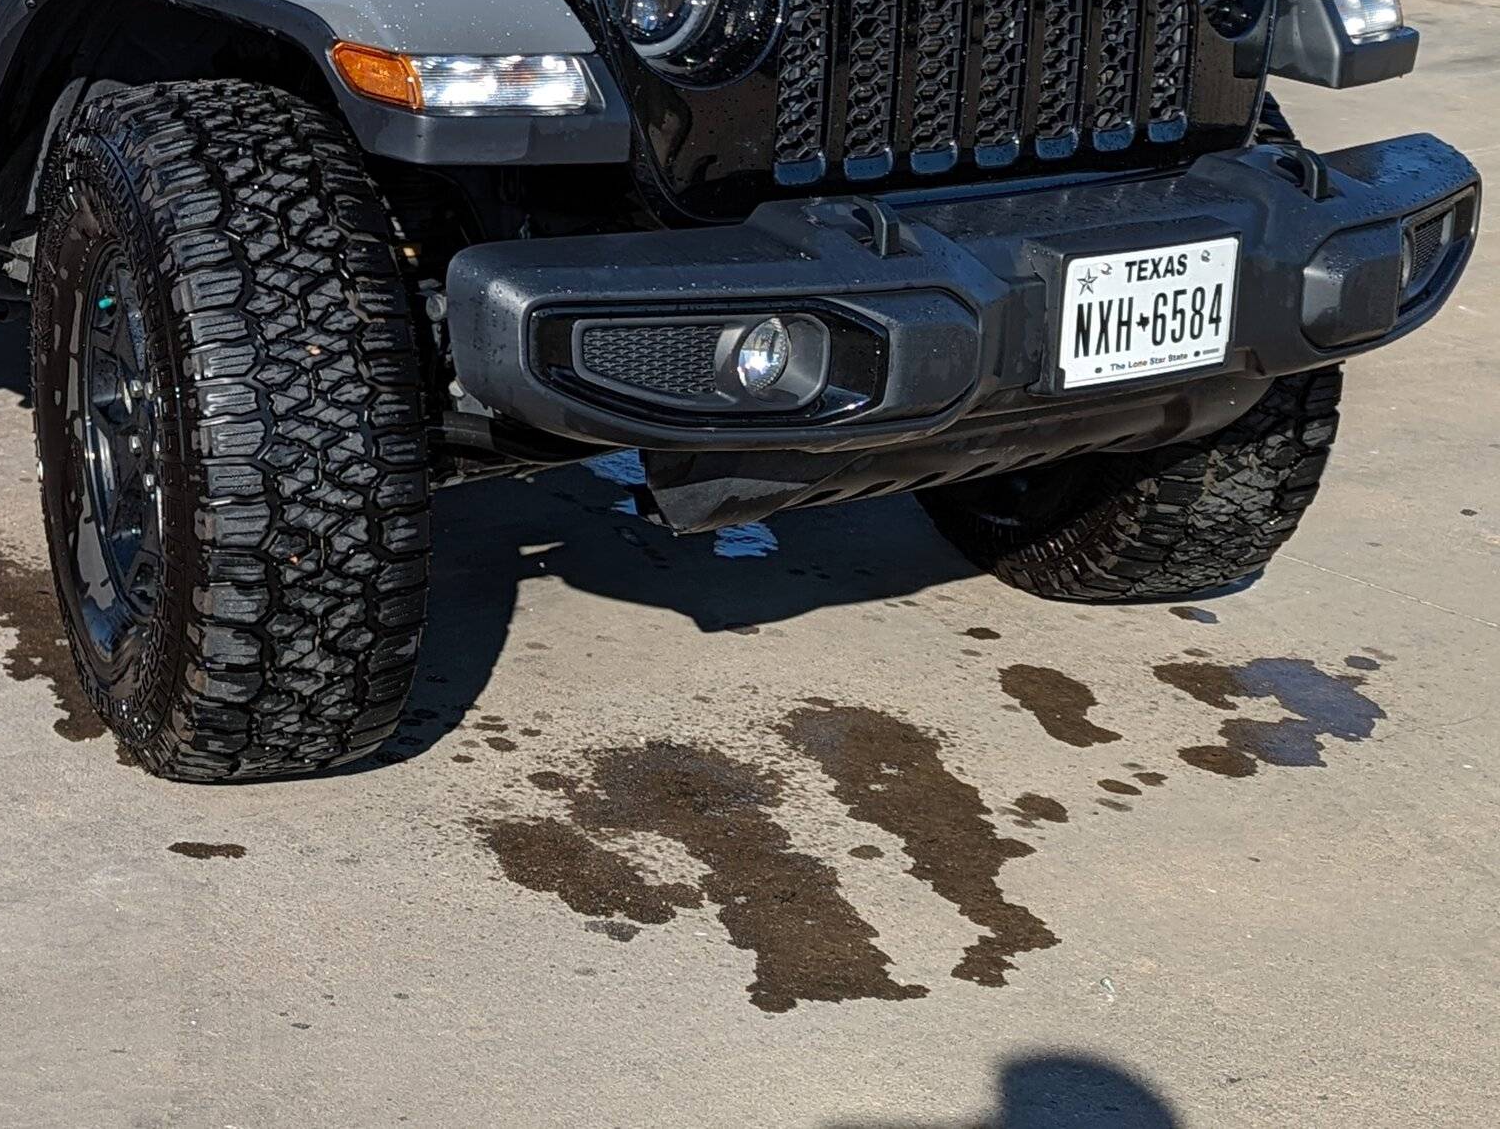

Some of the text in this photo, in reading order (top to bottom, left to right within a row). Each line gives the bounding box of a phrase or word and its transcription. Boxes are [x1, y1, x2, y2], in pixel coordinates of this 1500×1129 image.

[1125, 254, 1188, 283] TEXAS
[1074, 283, 1223, 359] NXH 6584
[1110, 353, 1188, 372] The Lone Star State
